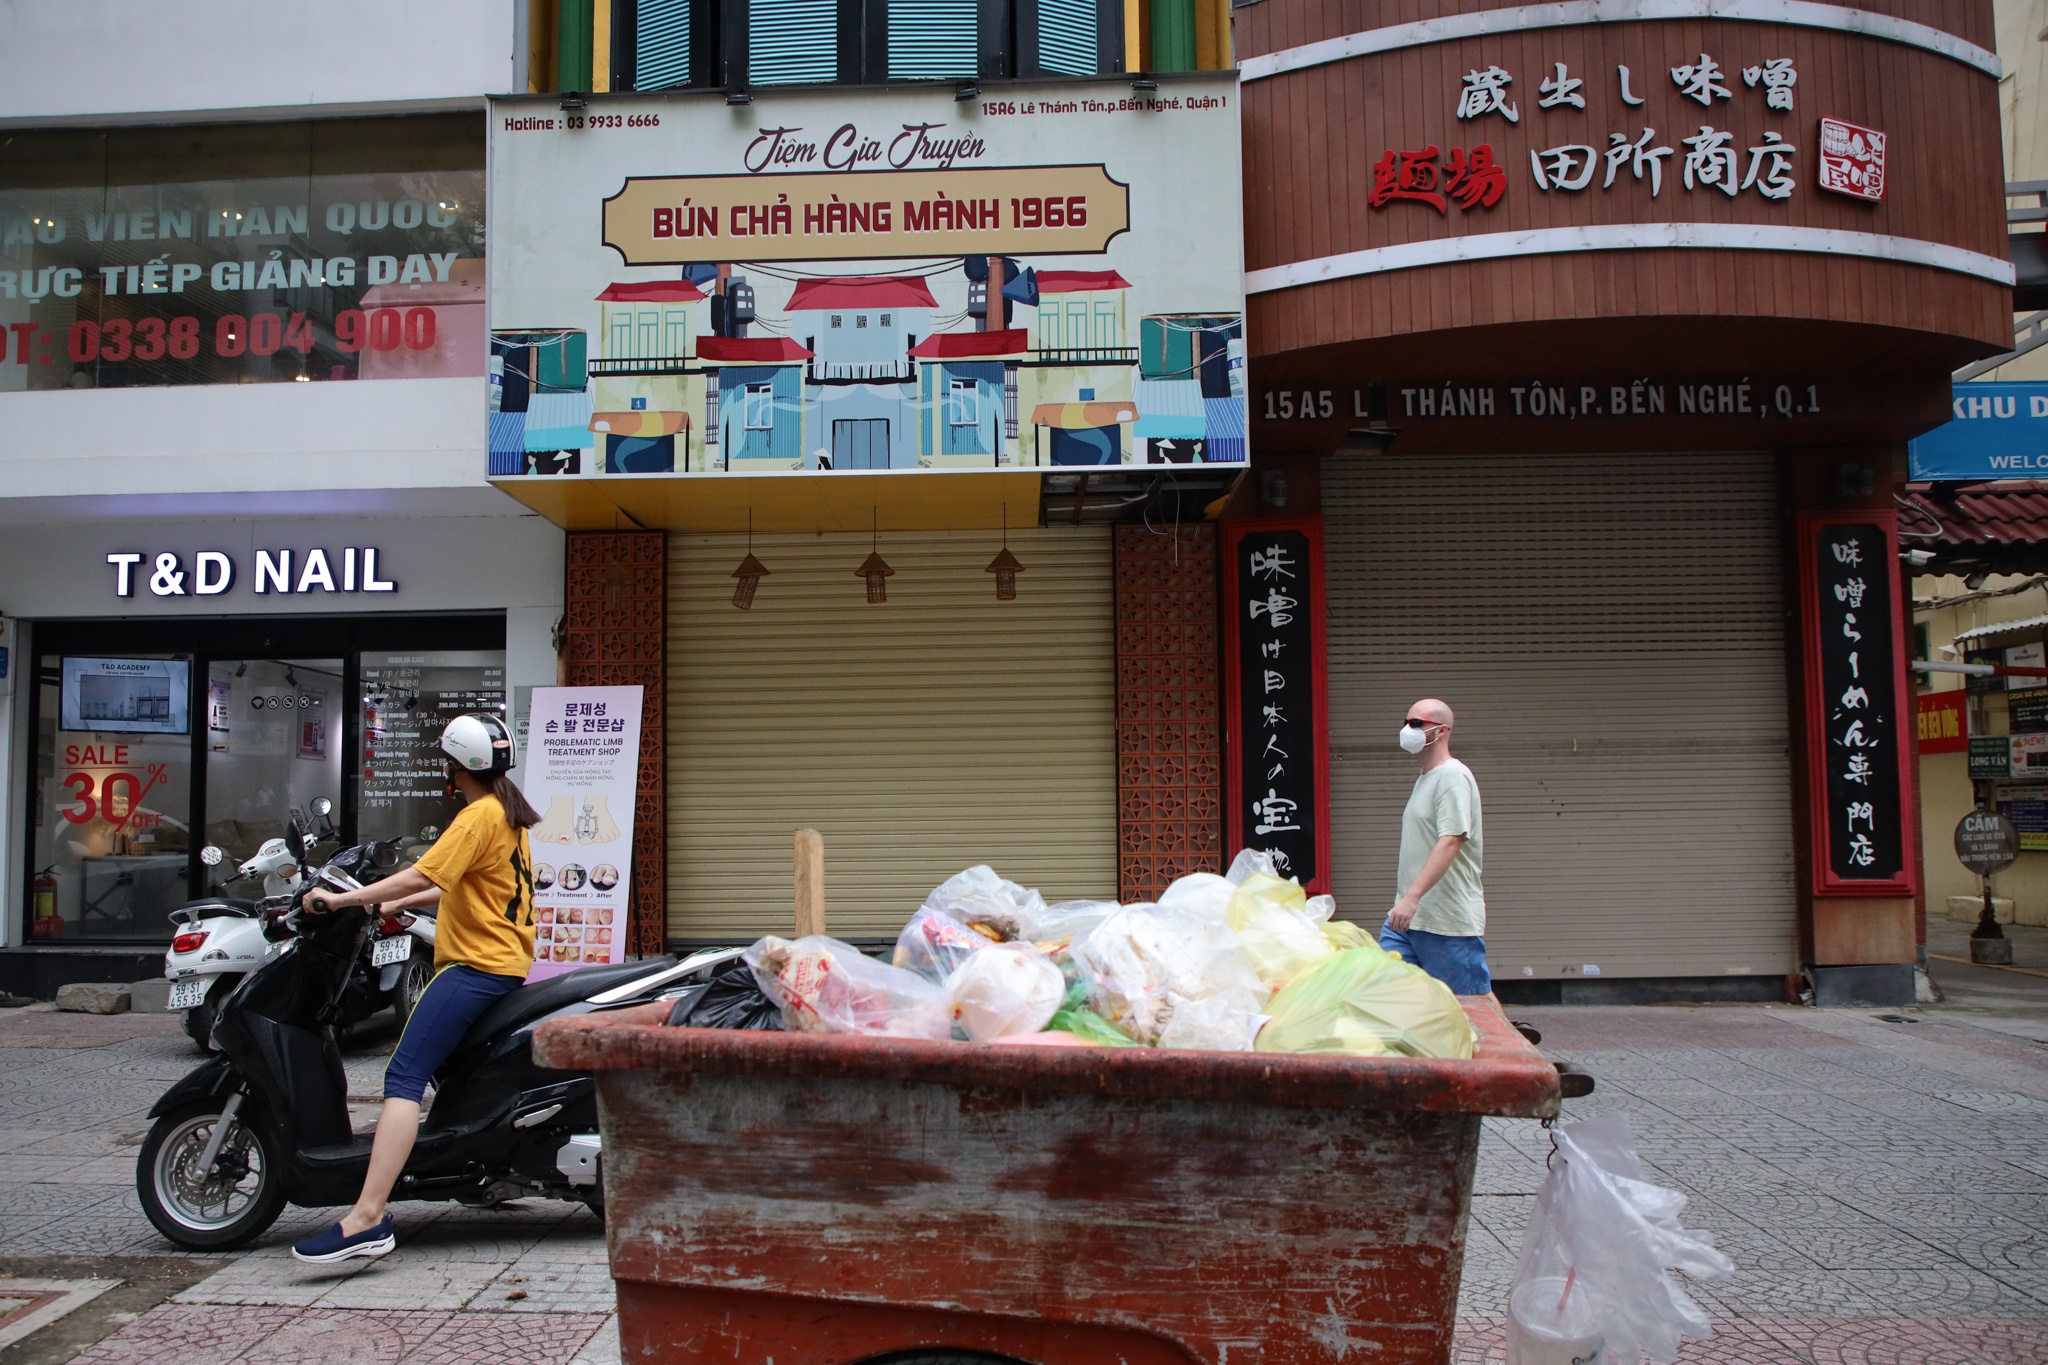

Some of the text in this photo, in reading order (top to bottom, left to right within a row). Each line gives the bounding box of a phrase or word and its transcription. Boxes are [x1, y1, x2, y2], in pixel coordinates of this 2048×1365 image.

[1456, 53, 1797, 123] 蔵出し味噌
[982, 101, 1016, 116] 15A6
[1021, 101, 1035, 114] Lê
[1039, 98, 1077, 113] Thánh
[1186, 96, 1218, 111] Quận
[1221, 96, 1226, 108] 1
[505, 116, 554, 131] Hotline
[567, 115, 584, 129] 03
[589, 114, 623, 128] 9933
[627, 113, 660, 128] 6666
[744, 122, 986, 173] Tiệm Gia Truyền
[1531, 126, 1797, 200] 田所商店
[653, 190, 1087, 239] BÚN CHẢ HÀNG MÀNH 1966
[100, 255, 201, 296] TIẾP
[211, 250, 355, 291] GIẢNG
[367, 252, 459, 290] DẠY
[68, 316, 199, 363] 0338
[215, 312, 316, 358] 004
[335, 307, 437, 354] 900
[1264, 390, 1334, 419] 15A5
[1401, 381, 1495, 416] THÁNH
[1953, 396, 2016, 419] KHU
[107, 547, 396, 596] T&D NAIL
[565, 703, 606, 716] 문제성
[1832, 538, 1880, 867] 味噌らーめん専門店
[545, 719, 625, 733] 손 발 전문샵
[544, 738, 623, 746] PROBLEMATIC LIMB
[65, 745, 129, 765] SALE
[548, 748, 620, 756] TREATMENT SHOP
[1971, 756, 1990, 766] LONG
[132, 814, 164, 828] OFF
[1965, 814, 1999, 832] CẤM
[380, 939, 405, 951] 59-X2
[375, 949, 407, 964] 689.41
[175, 983, 200, 995] 59-S1
[170, 993, 203, 1008] 455.35
